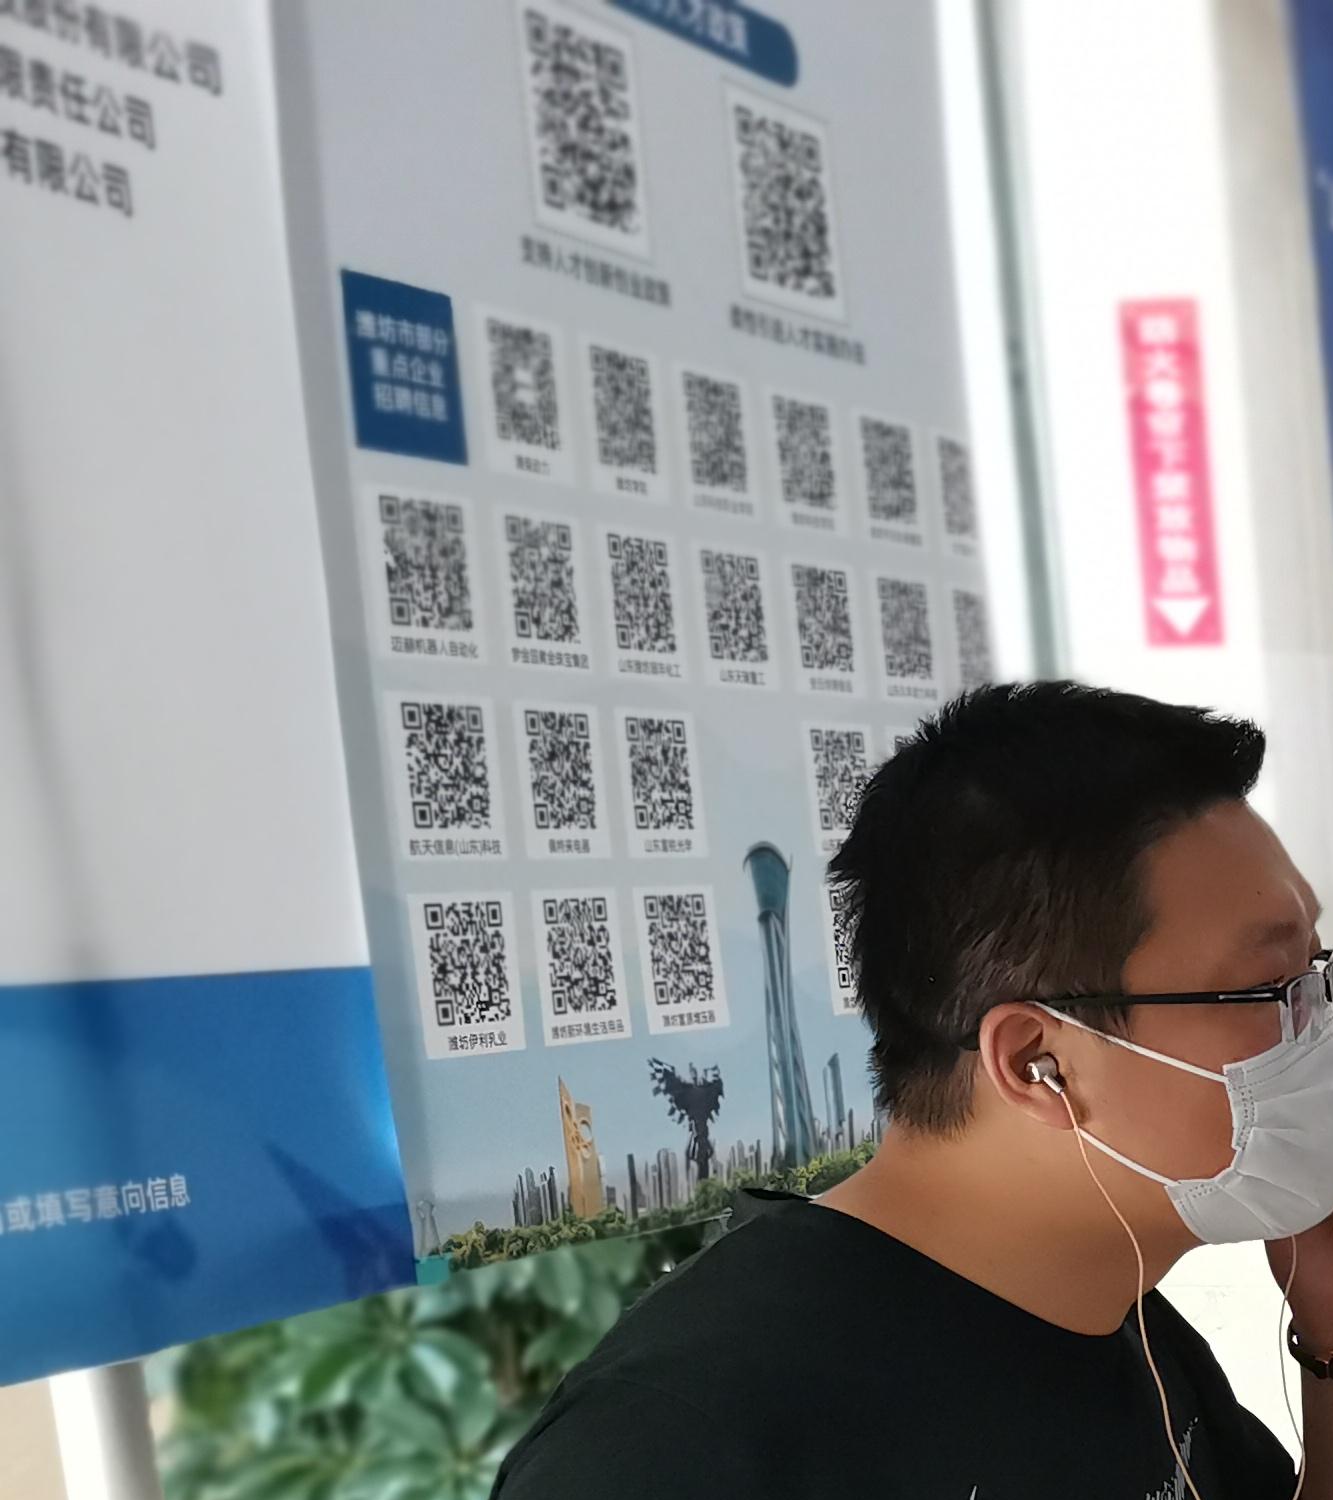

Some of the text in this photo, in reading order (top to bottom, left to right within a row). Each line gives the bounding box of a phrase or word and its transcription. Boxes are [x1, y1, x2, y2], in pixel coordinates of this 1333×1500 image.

[355, 309, 449, 357] 潍坊市部分
[371, 346, 446, 389] 重点企业
[373, 380, 450, 423] 招聘信息
[447, 1030, 508, 1051] 潍坊伊利乳业
[0, 1173, 192, 1236] 或填写意向信息
